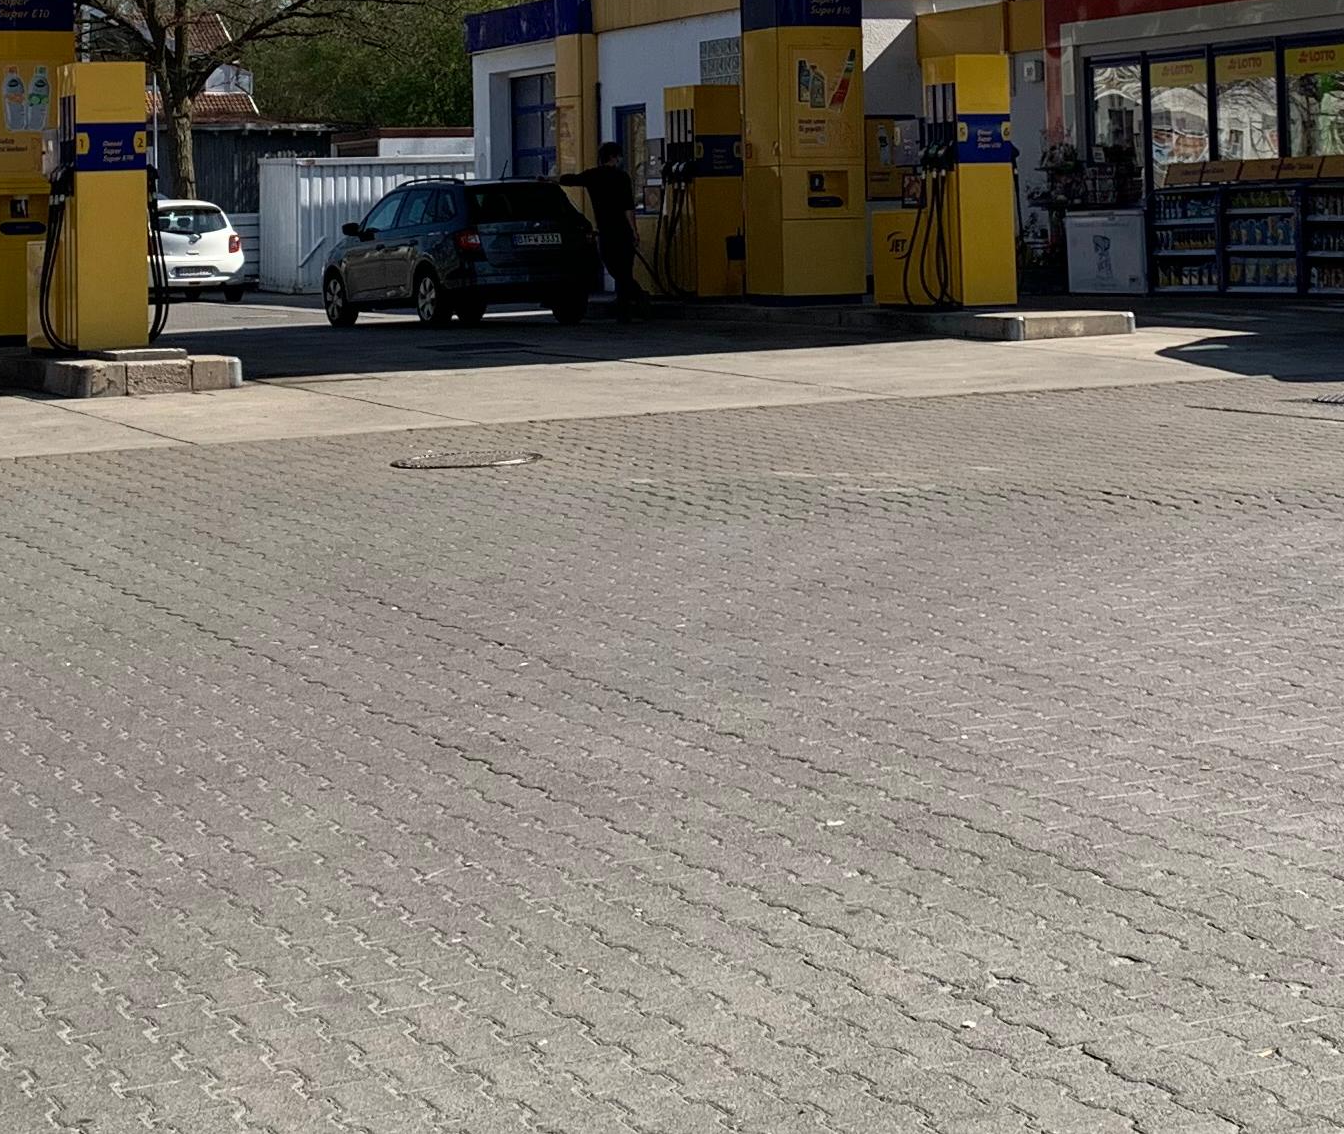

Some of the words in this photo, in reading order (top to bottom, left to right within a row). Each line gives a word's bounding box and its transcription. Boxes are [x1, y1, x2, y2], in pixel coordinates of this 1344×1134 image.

[810, 5, 836, 16] Super
[1308, 49, 1336, 62] LOTTO
[1238, 57, 1263, 69] LOTTO
[889, 239, 907, 253] JET
